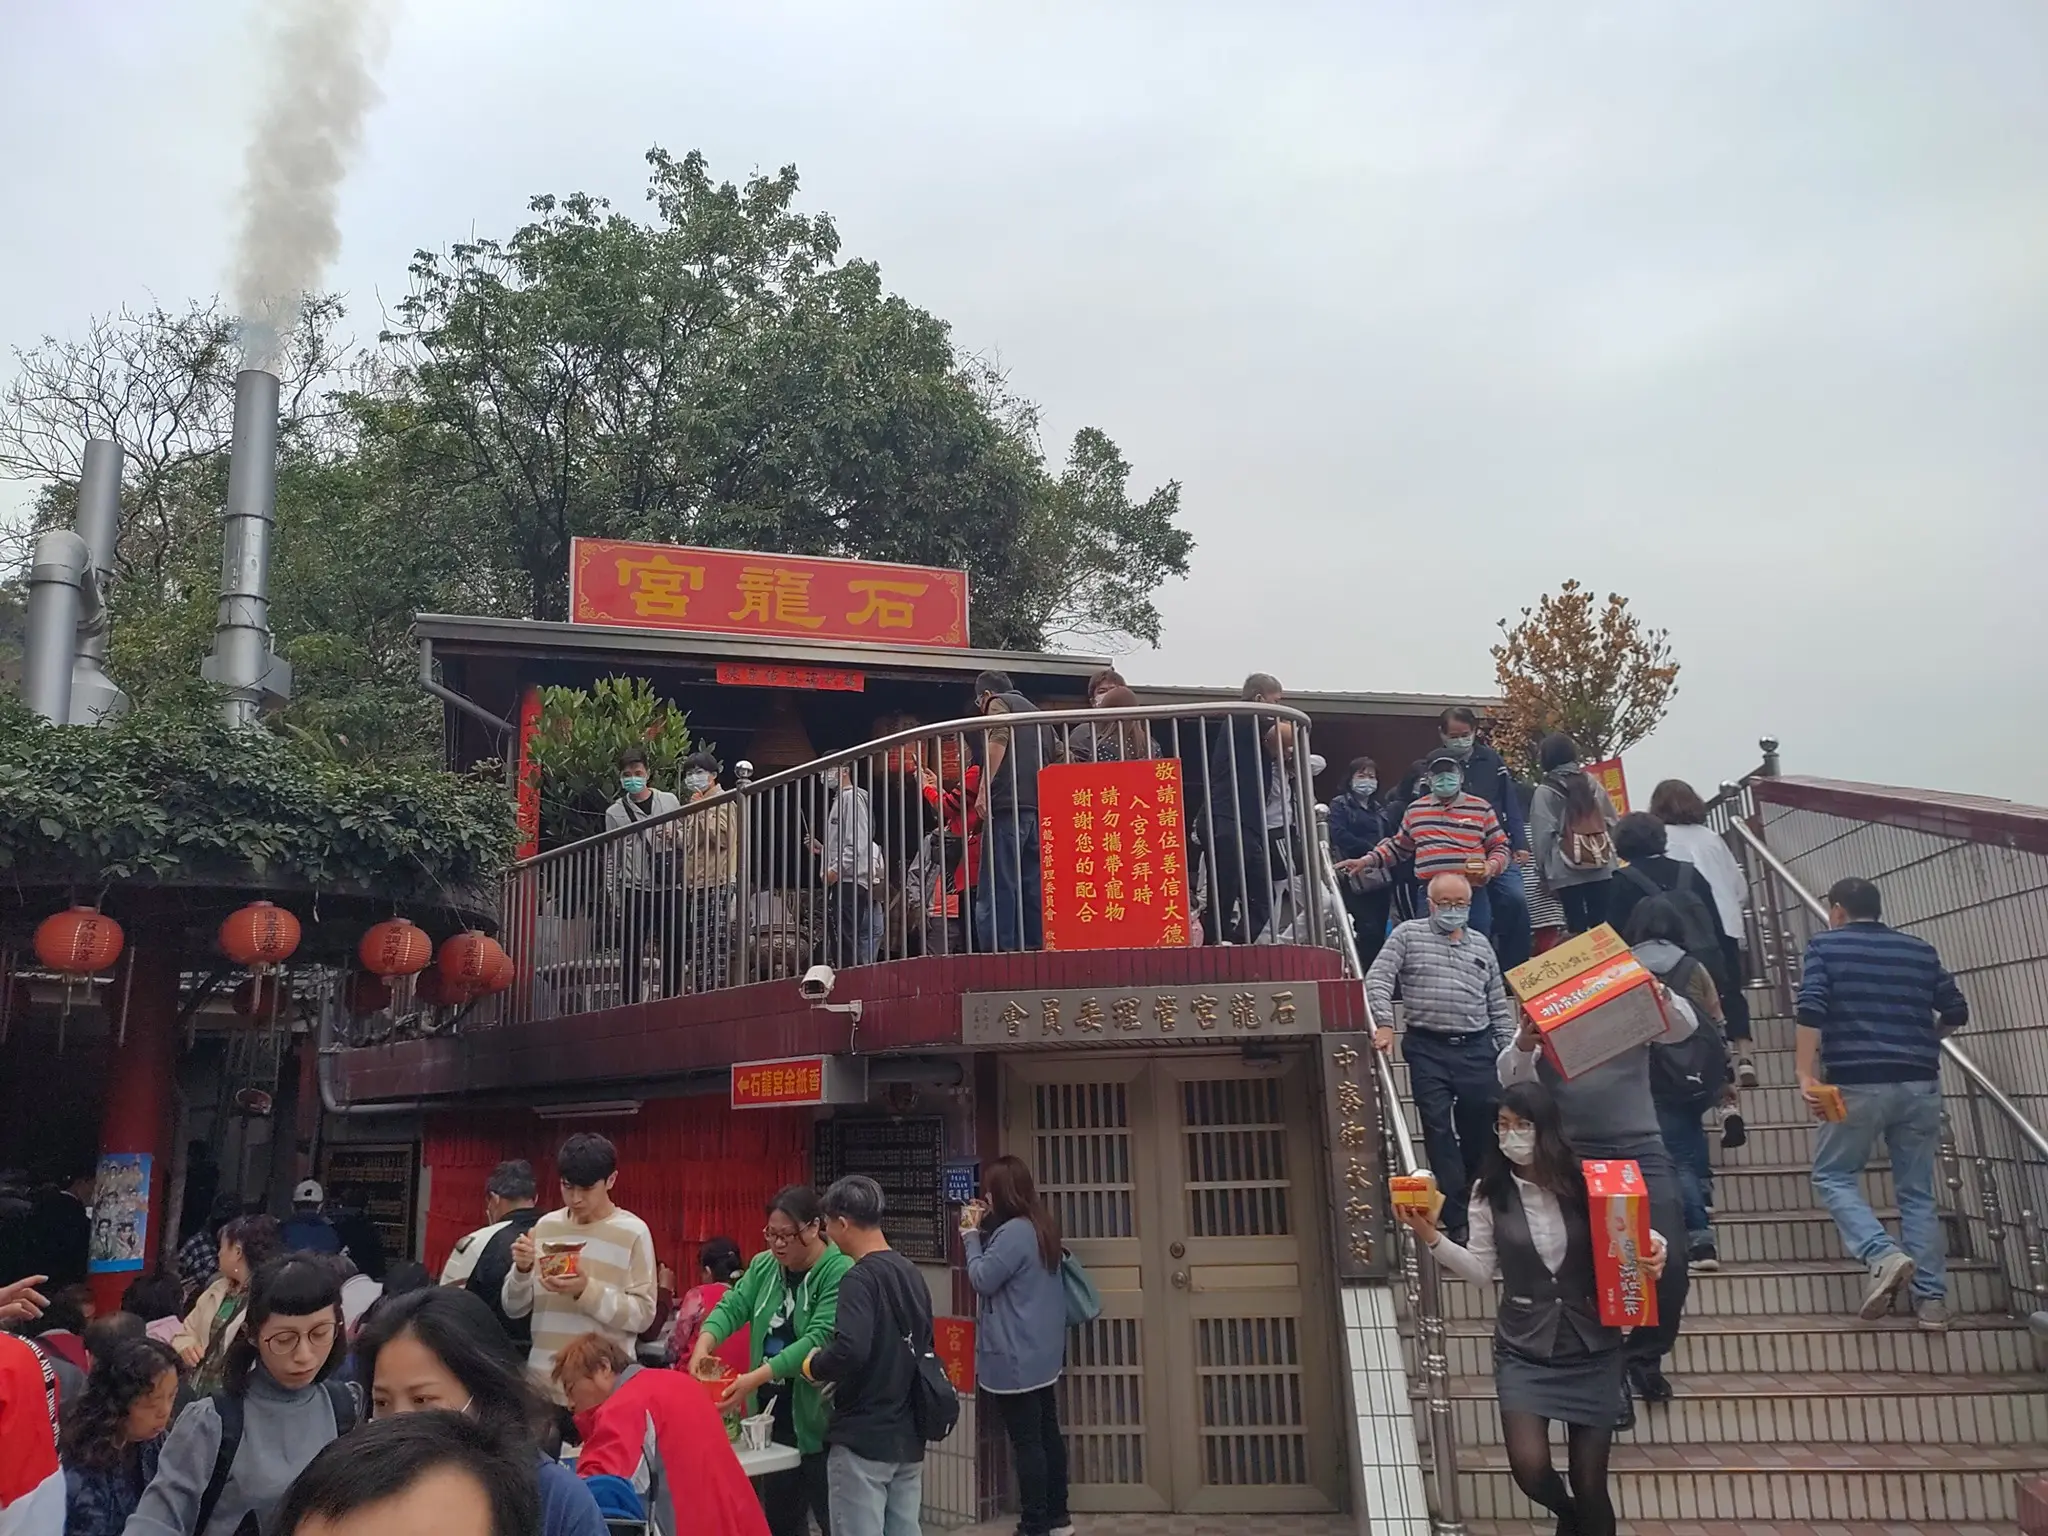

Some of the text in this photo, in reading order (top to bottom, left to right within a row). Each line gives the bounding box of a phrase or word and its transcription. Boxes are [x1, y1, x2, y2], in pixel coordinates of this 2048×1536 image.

[615, 554, 929, 630] 石龍宮
[1041, 816, 1057, 921] 石龍宮管理委員會
[1072, 788, 1098, 923] 謝謝您的配合
[1100, 786, 1125, 922] 請勿攜帶寵物
[1129, 795, 1153, 906] 入宮參拜時
[1155, 762, 1185, 944] 敬請諸位善信大德
[77, 918, 98, 961] 石龍宮
[998, 990, 1298, 1038] 石龍宮管理委員會
[39, 1358, 56, 1383] STAY
